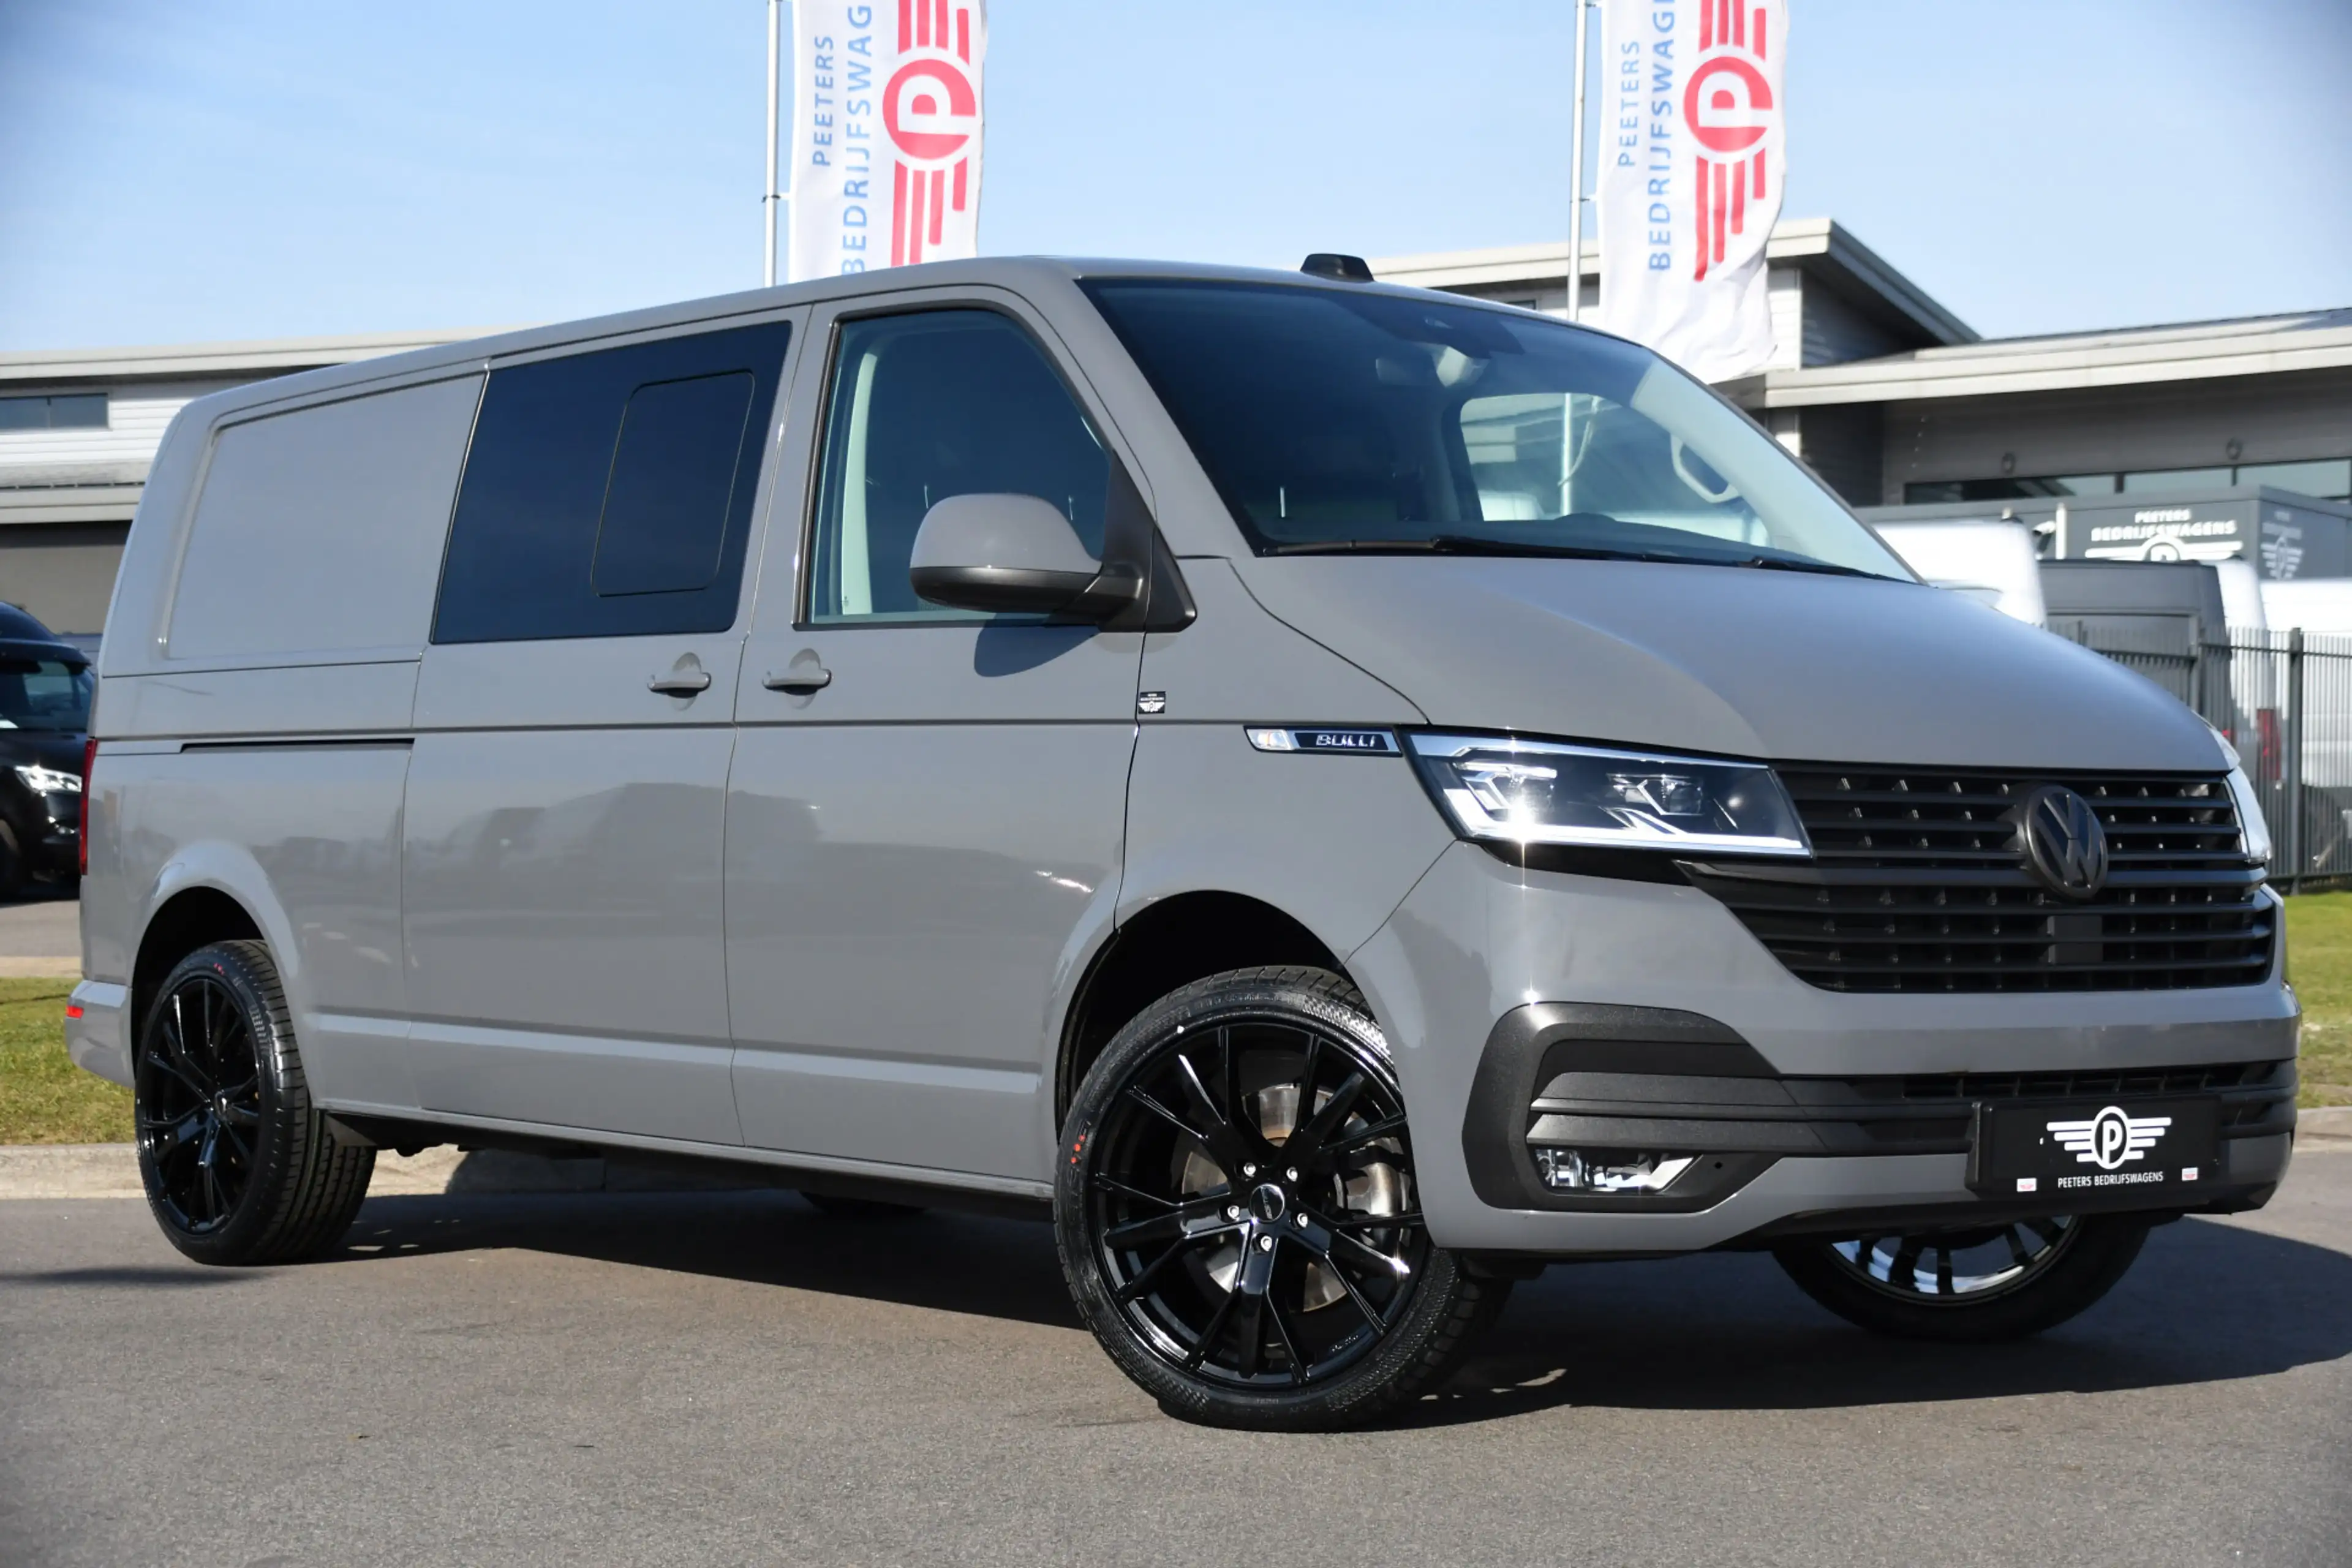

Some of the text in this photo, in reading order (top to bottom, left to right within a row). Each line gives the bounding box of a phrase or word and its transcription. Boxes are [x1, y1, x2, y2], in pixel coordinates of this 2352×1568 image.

[812, 36, 834, 167] PEETERS
[1618, 41, 1640, 167] PEETERS
[1648, 0, 1675, 271] BEDRIJFSWAG
[1316, 734, 1376, 747] BULLI
[2058, 1170, 2164, 1189] PEETERS BEDRIJFSWAGENS
